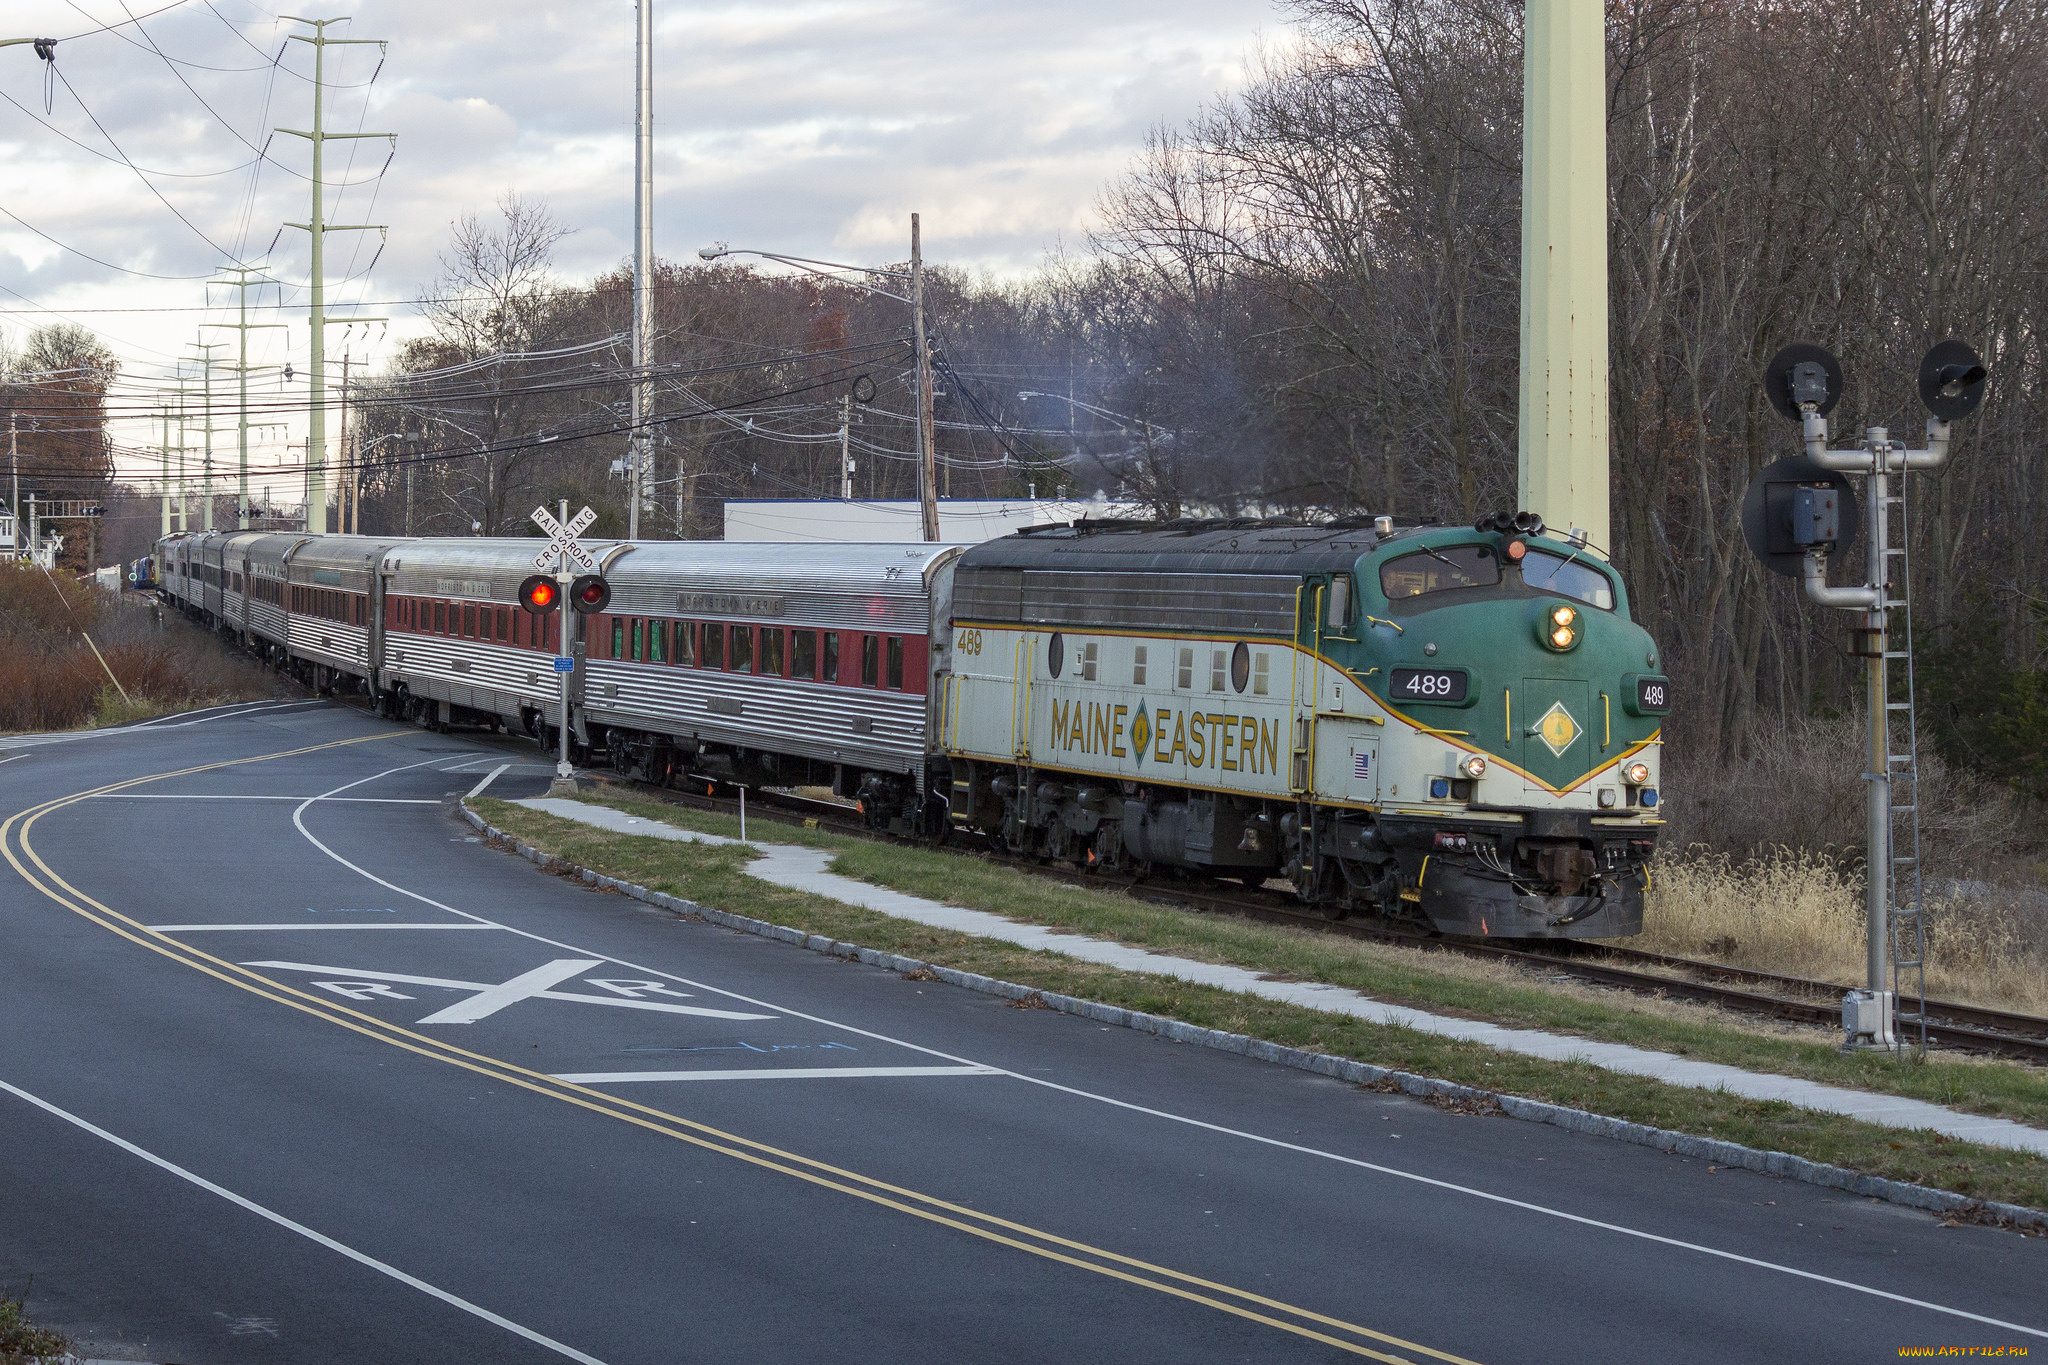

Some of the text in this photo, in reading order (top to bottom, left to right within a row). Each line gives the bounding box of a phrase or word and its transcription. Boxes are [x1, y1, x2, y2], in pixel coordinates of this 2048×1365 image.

[535, 510, 594, 568] CROSSING
[957, 629, 982, 656] 489
[1406, 674, 1451, 695] 489
[1644, 685, 1664, 705] 489
[1051, 698, 1279, 776] MAINE EASTERN
[309, 981, 418, 1000] R
[583, 978, 696, 998] R
